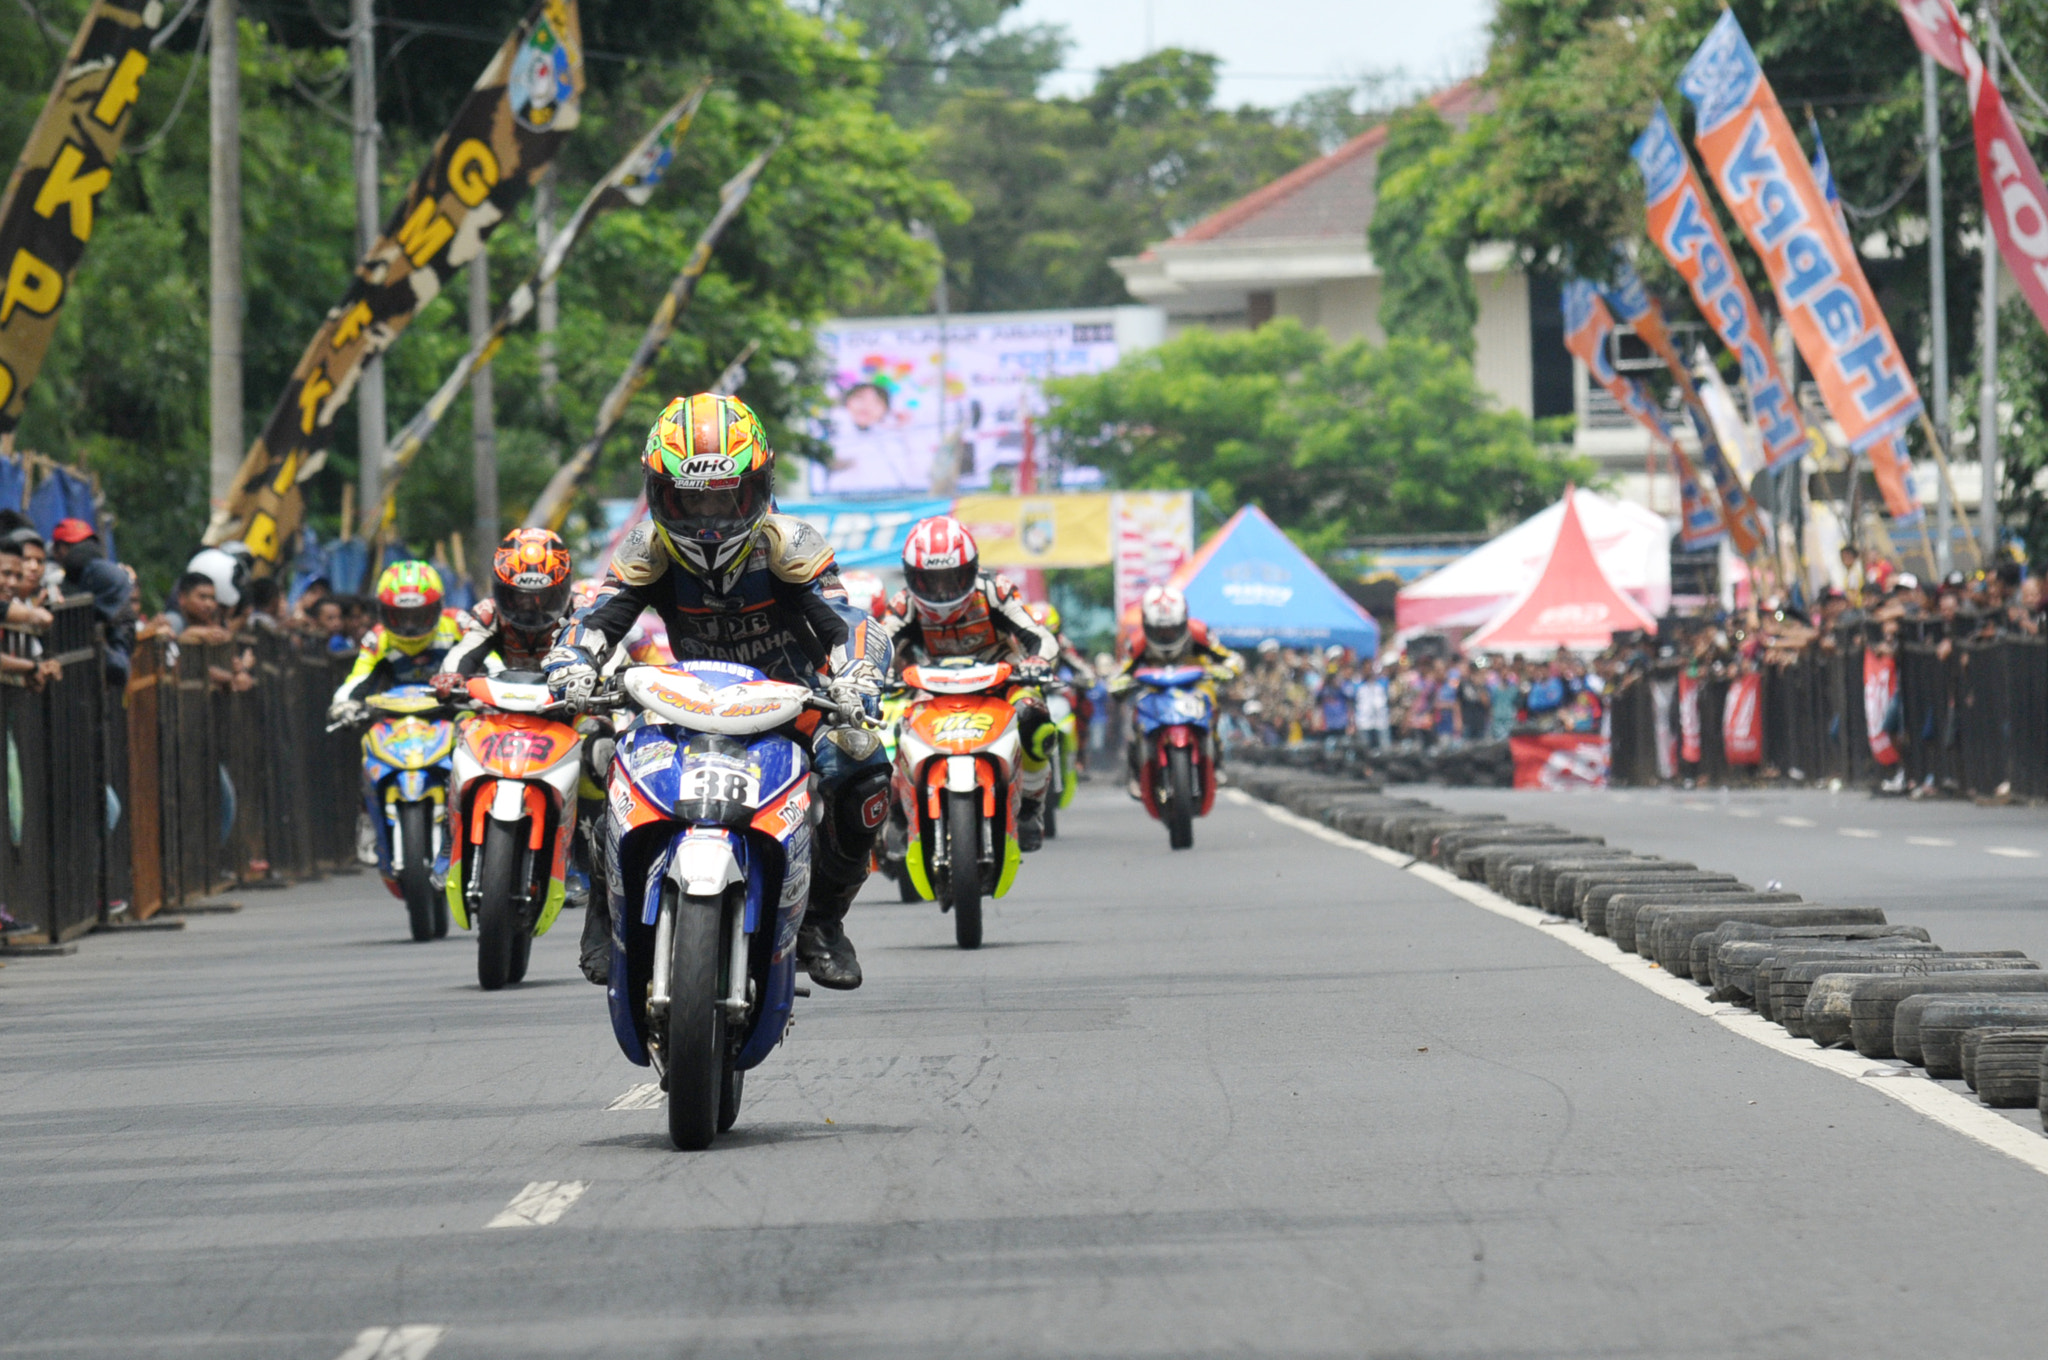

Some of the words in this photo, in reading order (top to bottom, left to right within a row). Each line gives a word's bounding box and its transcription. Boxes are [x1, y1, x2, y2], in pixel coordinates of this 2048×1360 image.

[686, 458, 730, 474] NHK
[518, 576, 546, 585] NHK
[703, 630, 797, 663] YAMAHA
[682, 660, 755, 681] YAMALUBE
[646, 681, 717, 717] YONK
[480, 731, 555, 765] 163
[694, 769, 749, 804] 38
